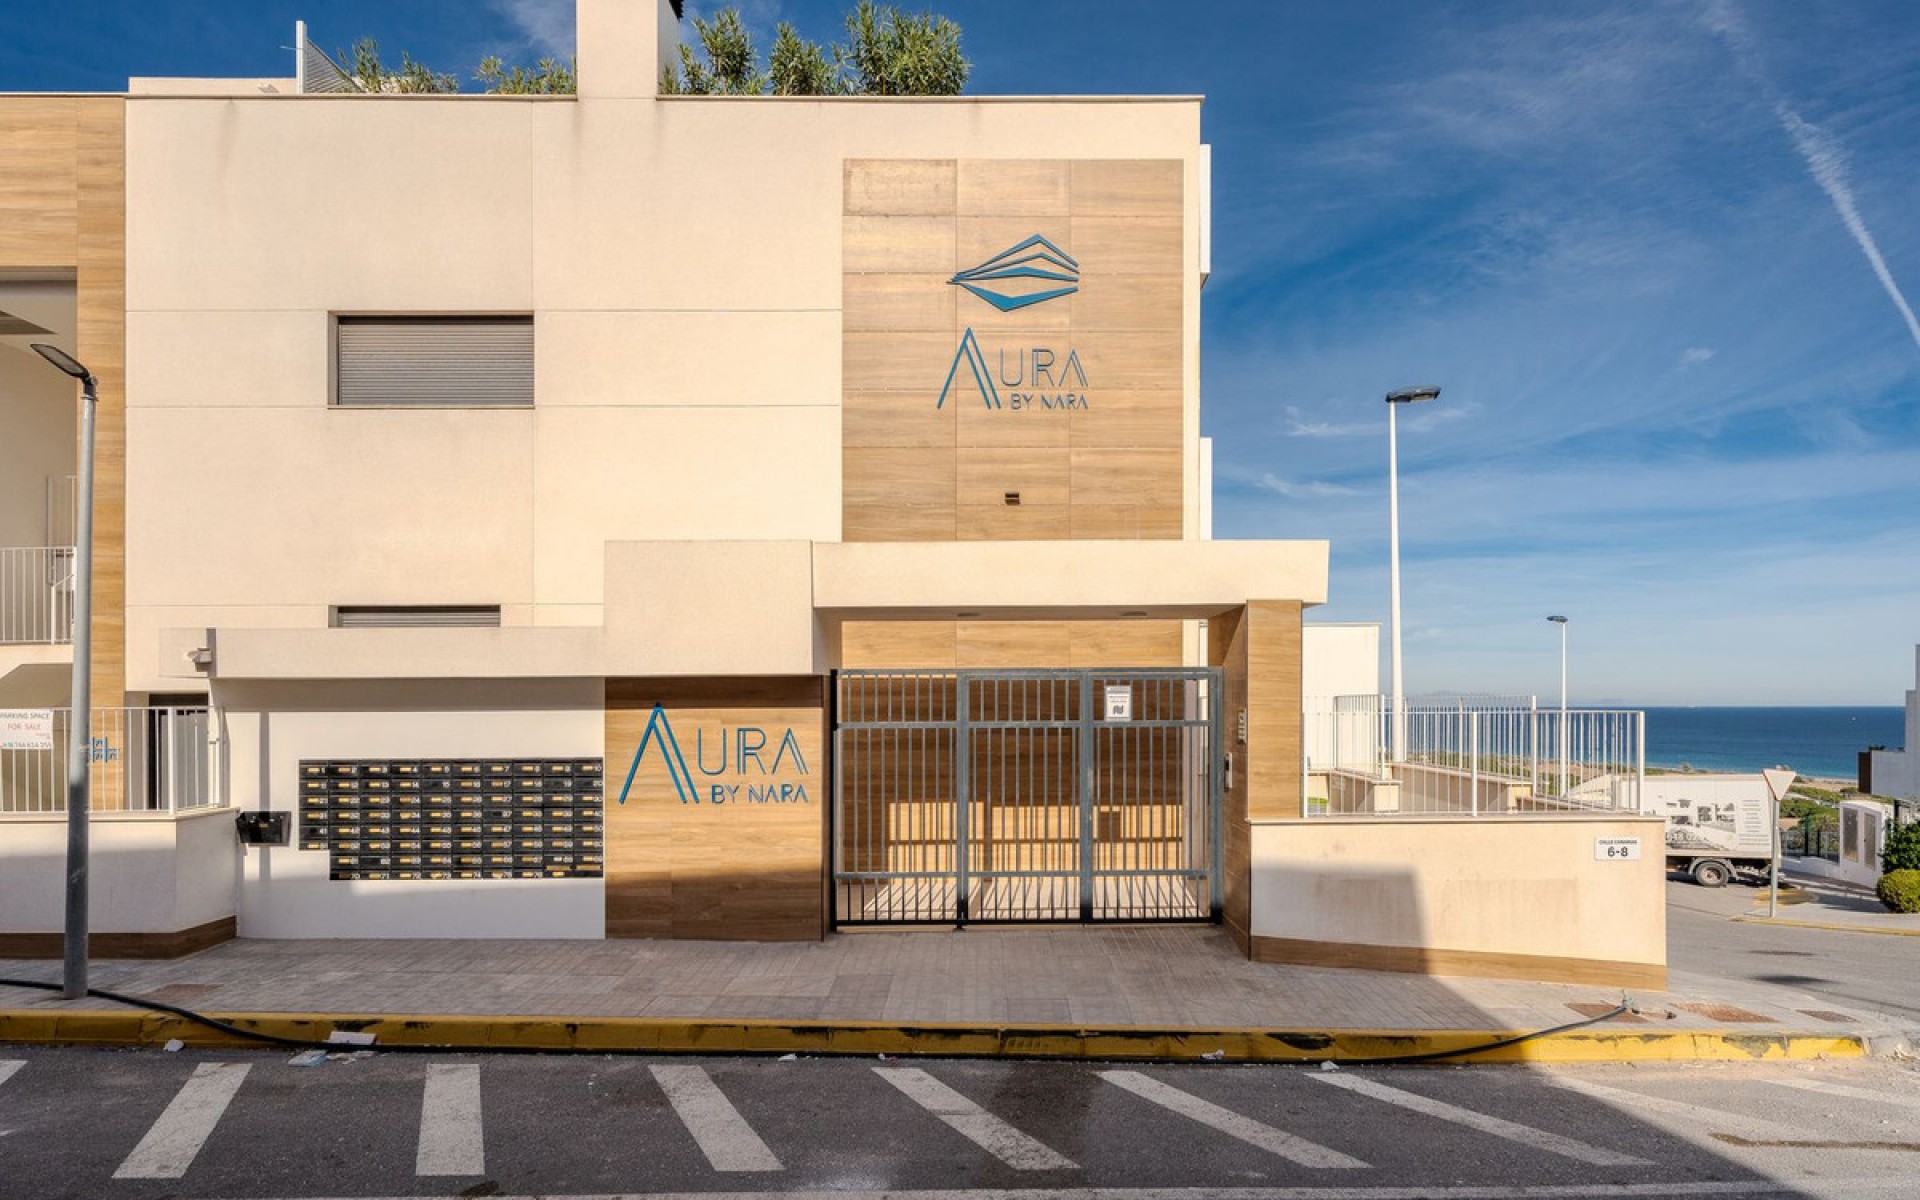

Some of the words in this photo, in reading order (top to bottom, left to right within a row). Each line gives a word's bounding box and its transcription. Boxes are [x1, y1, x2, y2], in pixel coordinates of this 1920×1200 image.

[936, 327, 1089, 409] AURA
[1010, 394, 1033, 410] BY
[1041, 394, 1088, 410] NARA
[618, 702, 809, 805] AURA
[711, 784, 740, 804] BY
[748, 784, 809, 804] NARA
[1608, 846, 1628, 857] 6-8
